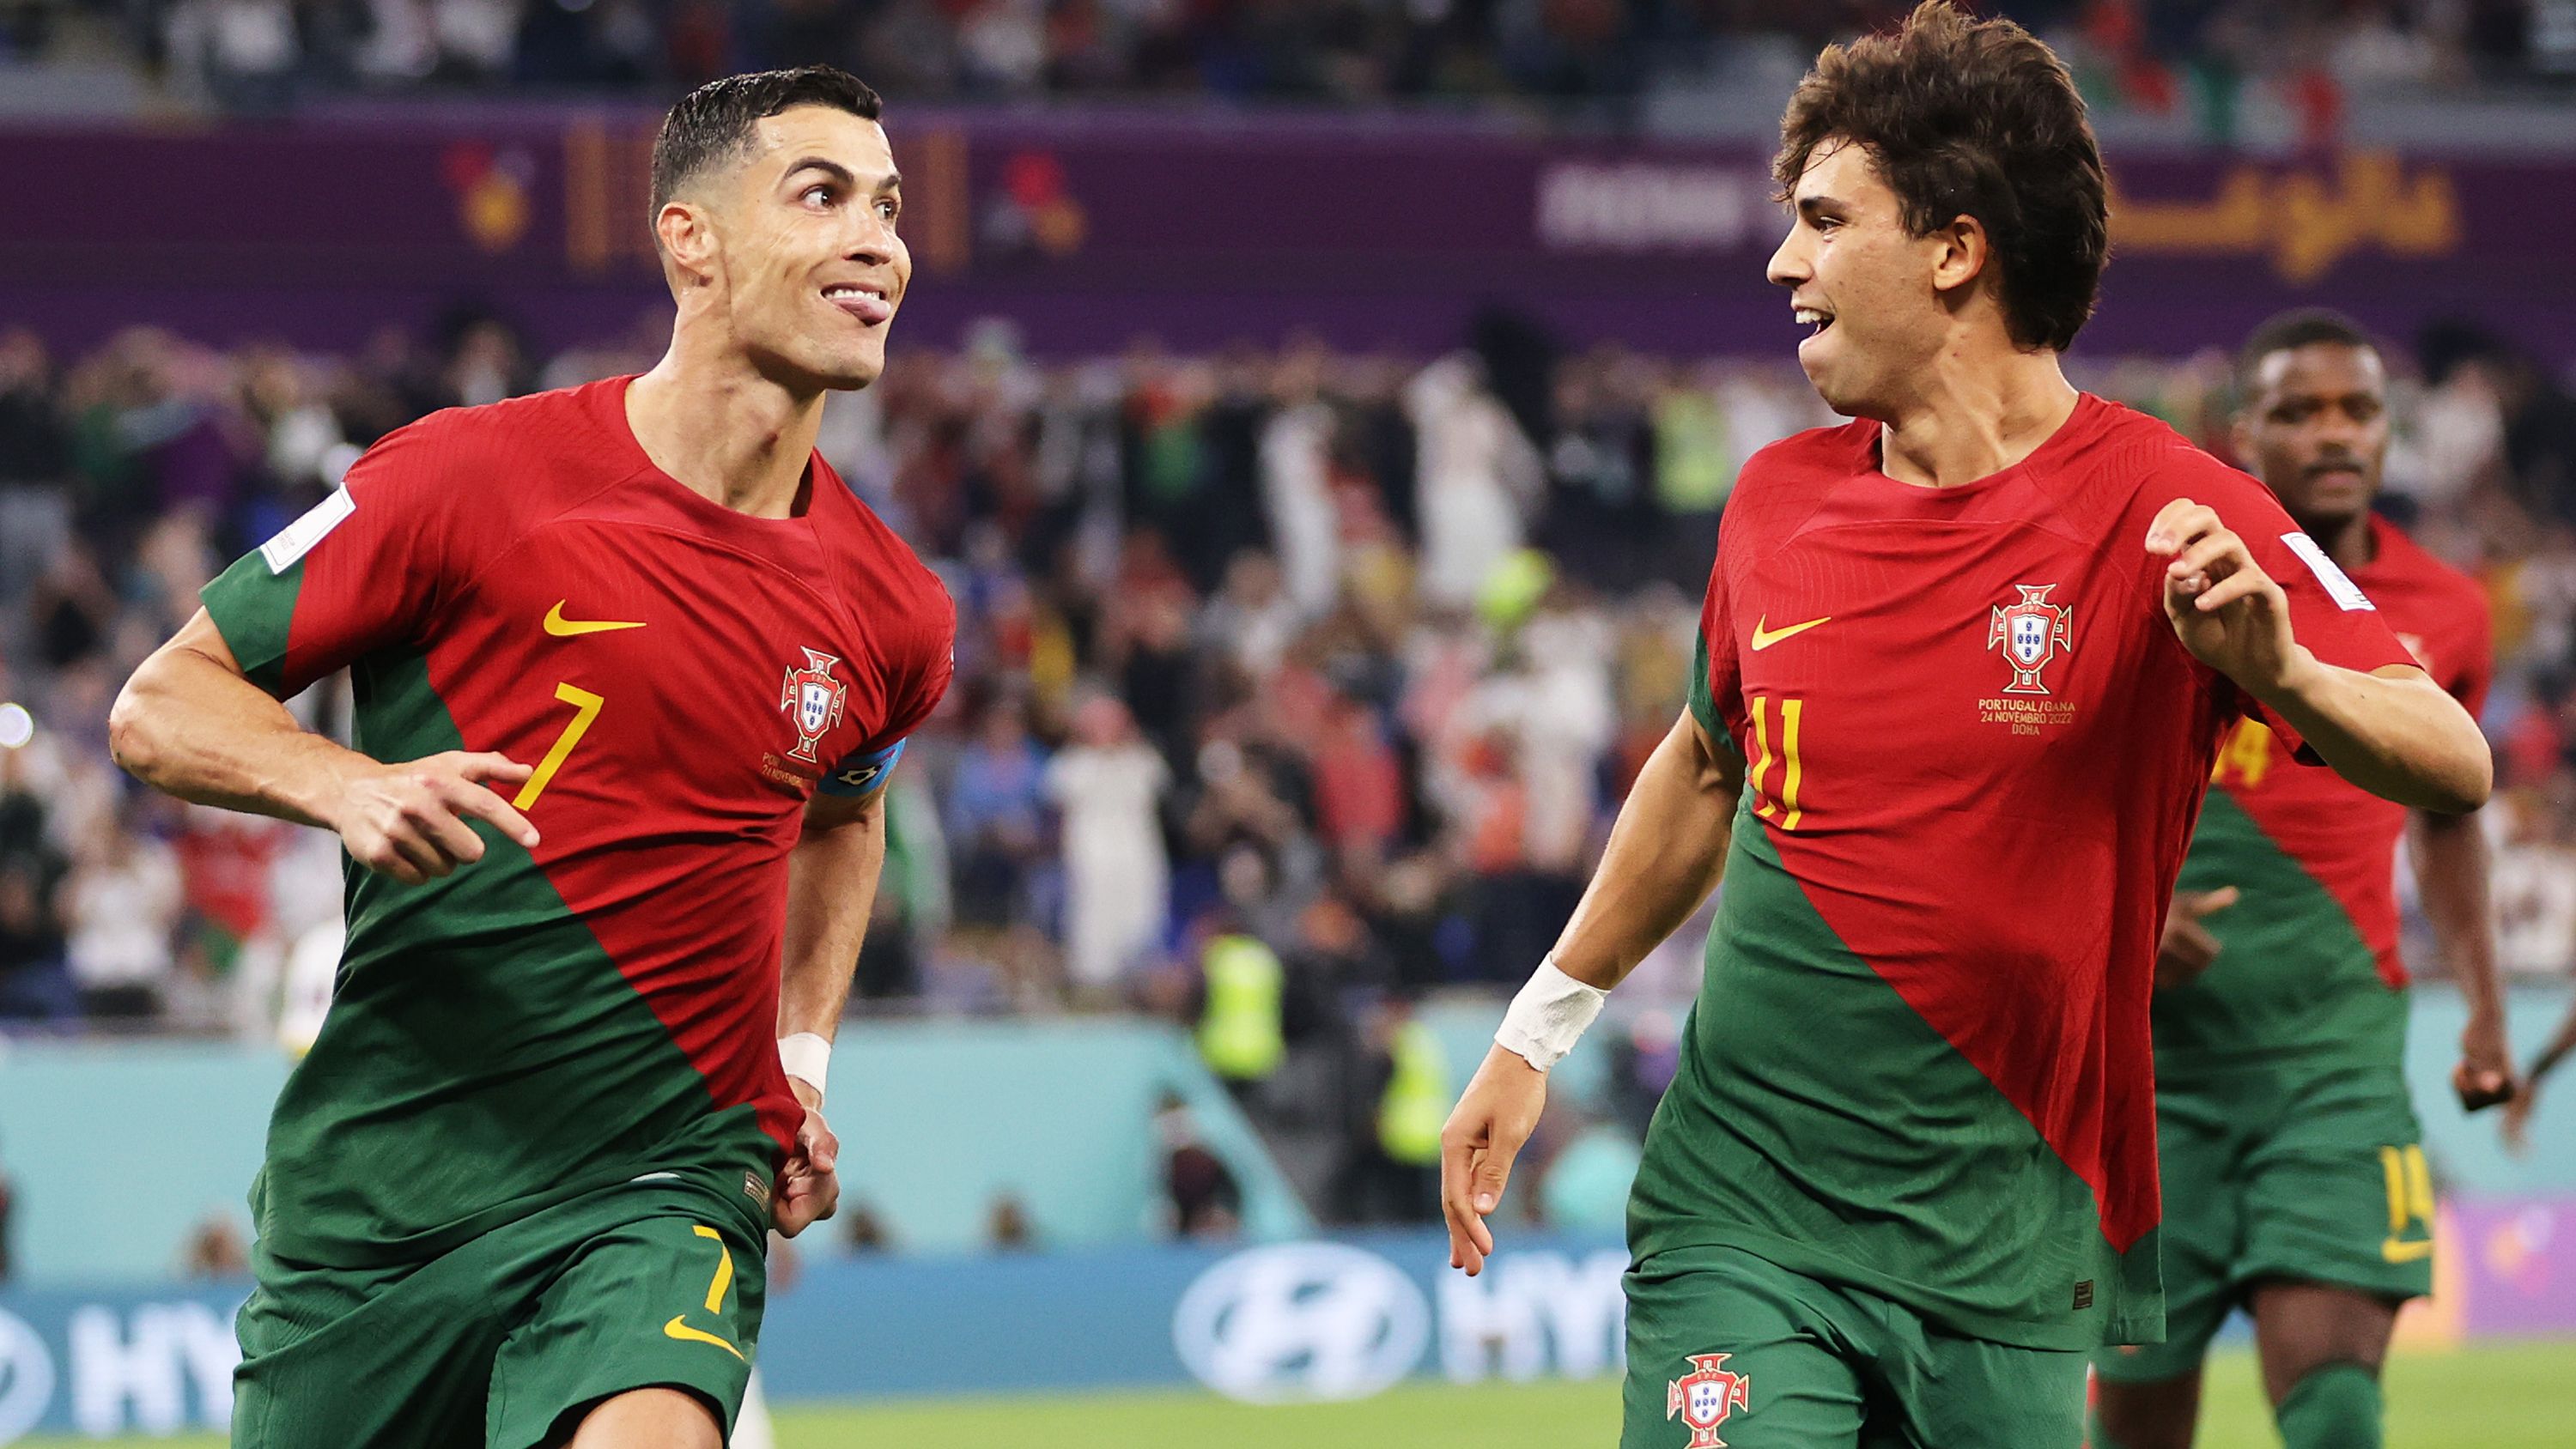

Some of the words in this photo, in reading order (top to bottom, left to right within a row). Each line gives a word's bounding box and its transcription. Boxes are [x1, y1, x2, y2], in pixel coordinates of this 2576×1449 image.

[512, 682, 605, 811] 7
[1753, 696, 1802, 830] 11
[1981, 711, 1993, 723] 24
[1995, 711, 2047, 724] NOVEMBRO
[2049, 712, 2073, 724] 2022
[2012, 723, 2040, 736] DOHA
[692, 1224, 734, 1315] 7
